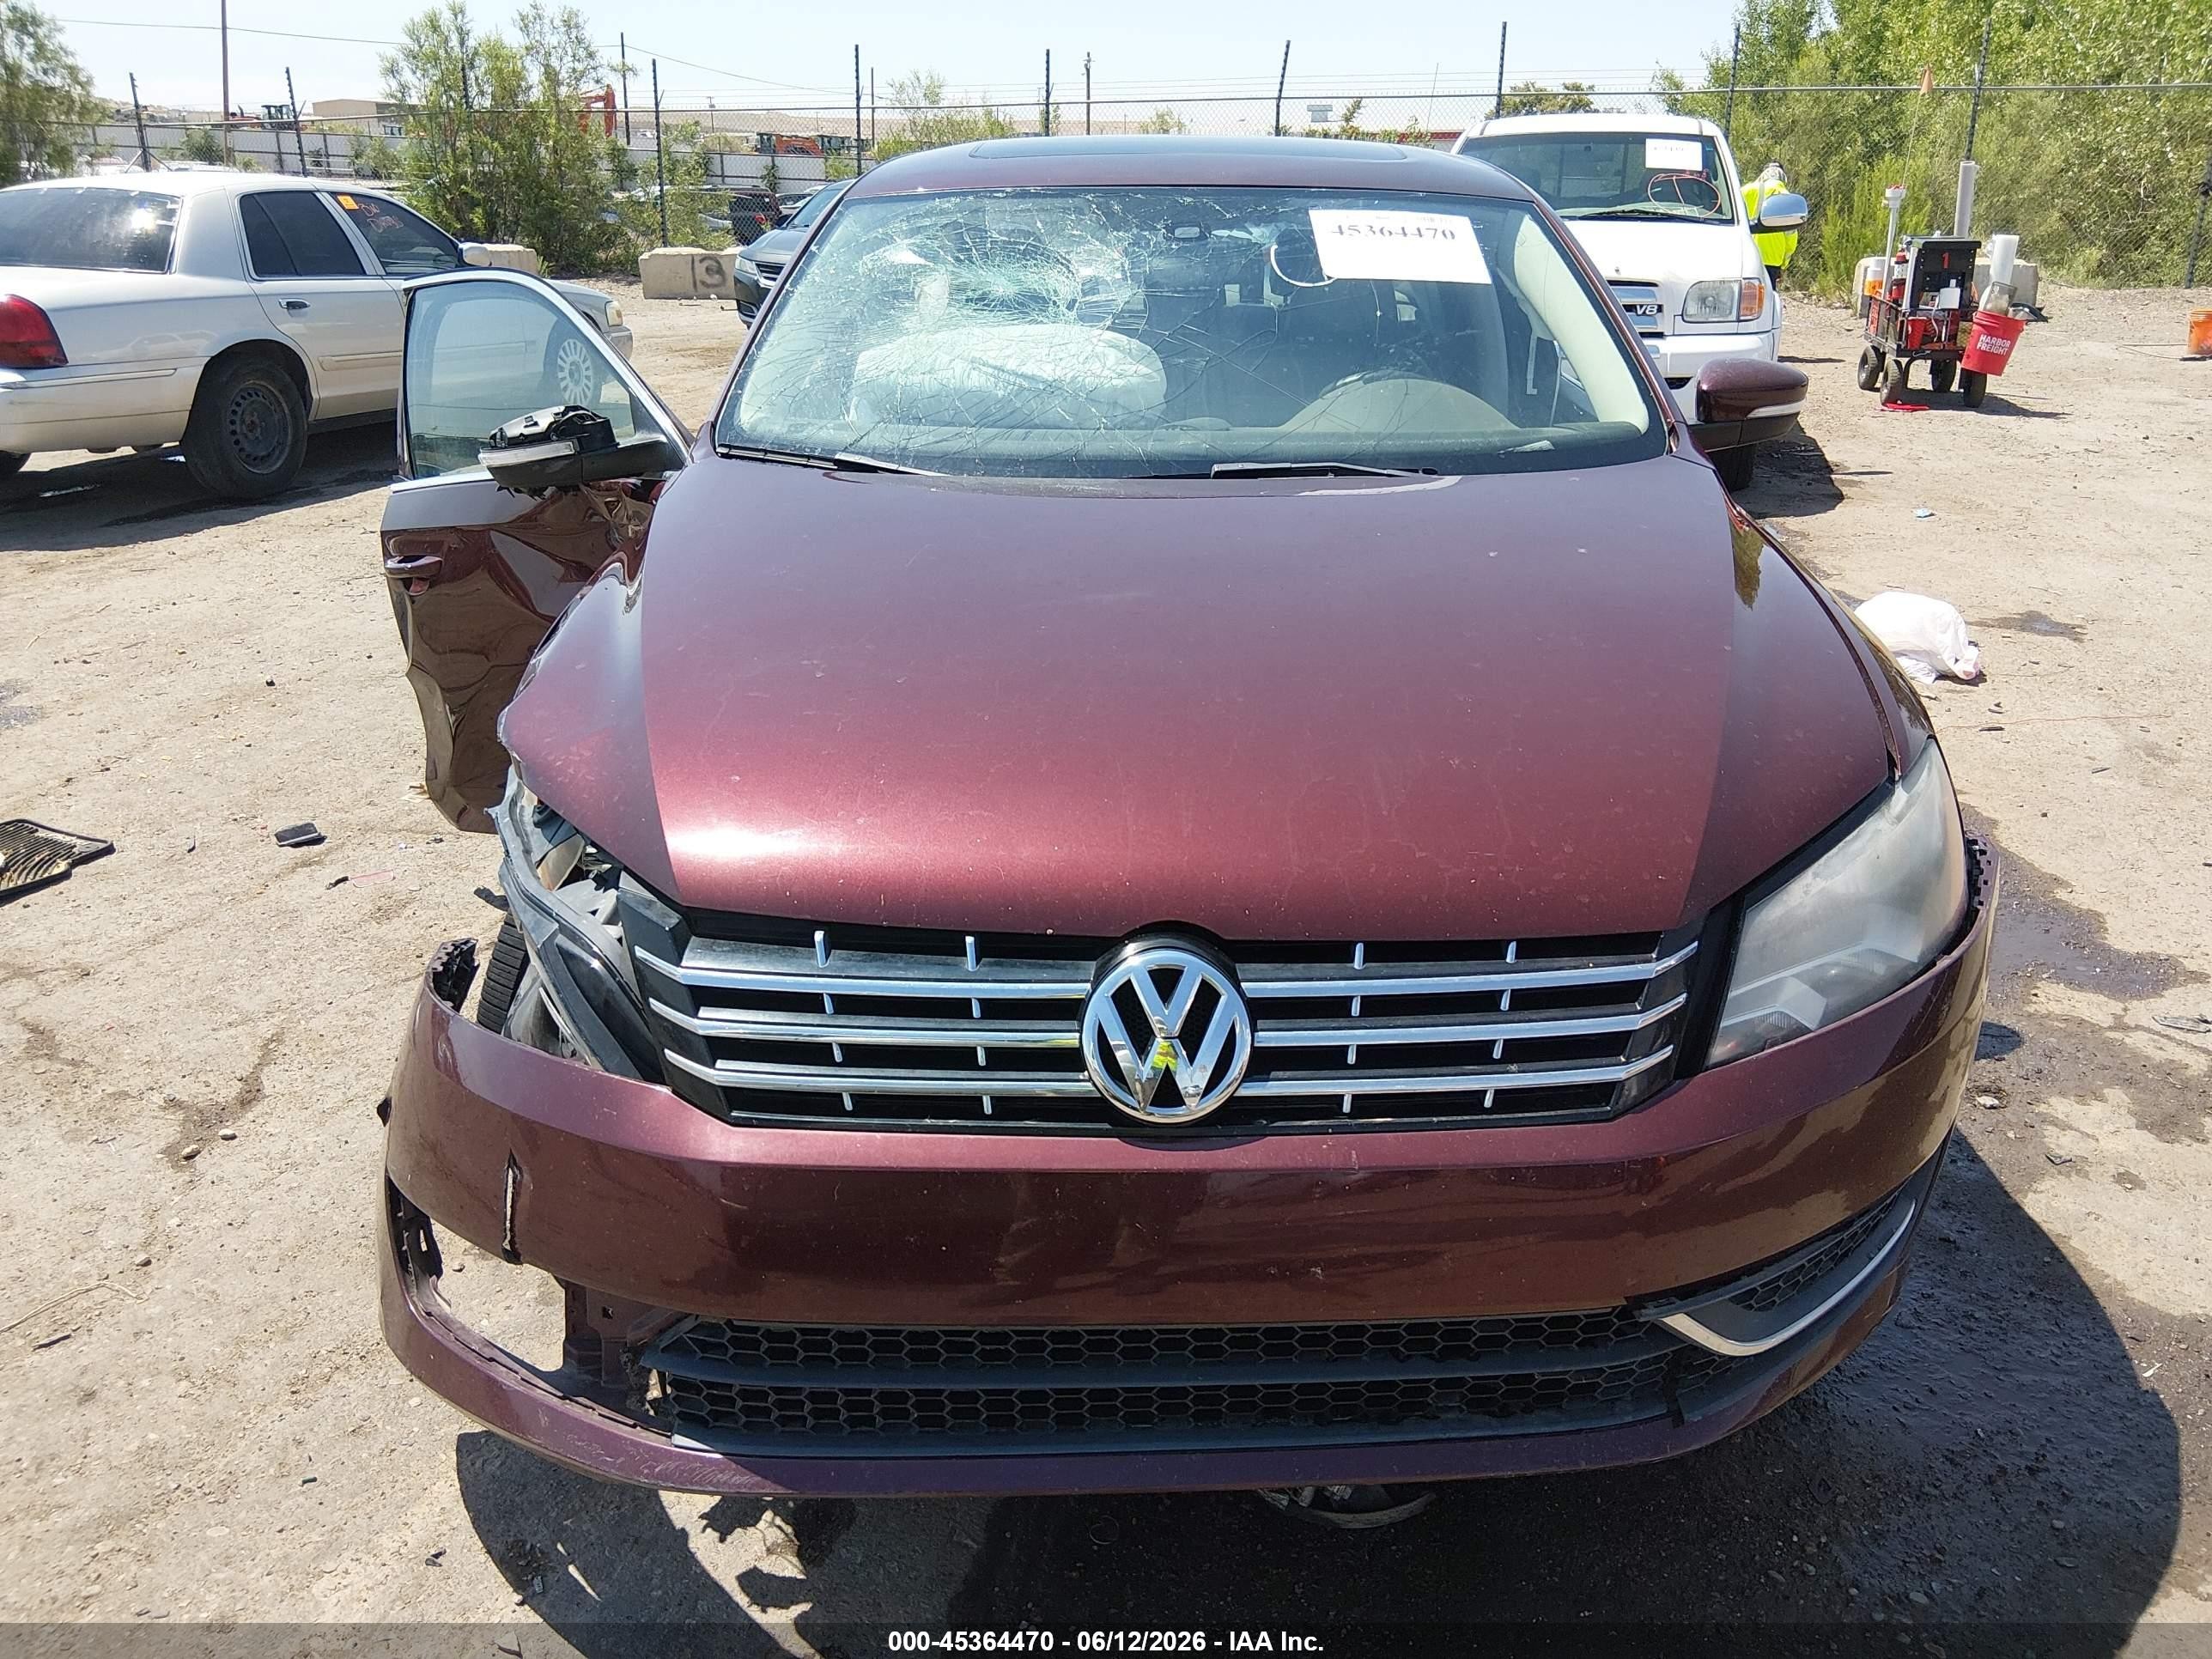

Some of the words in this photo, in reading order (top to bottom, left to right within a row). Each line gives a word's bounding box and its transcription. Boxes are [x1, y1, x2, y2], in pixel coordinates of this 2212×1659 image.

[1332, 223, 1457, 241] 45364470
[1942, 252, 1950, 269] 1
[690, 253, 727, 293] 13
[1635, 304, 1658, 315] V8
[1976, 341, 2009, 356] FREIGHT
[1978, 333, 2011, 348] HARBOR
